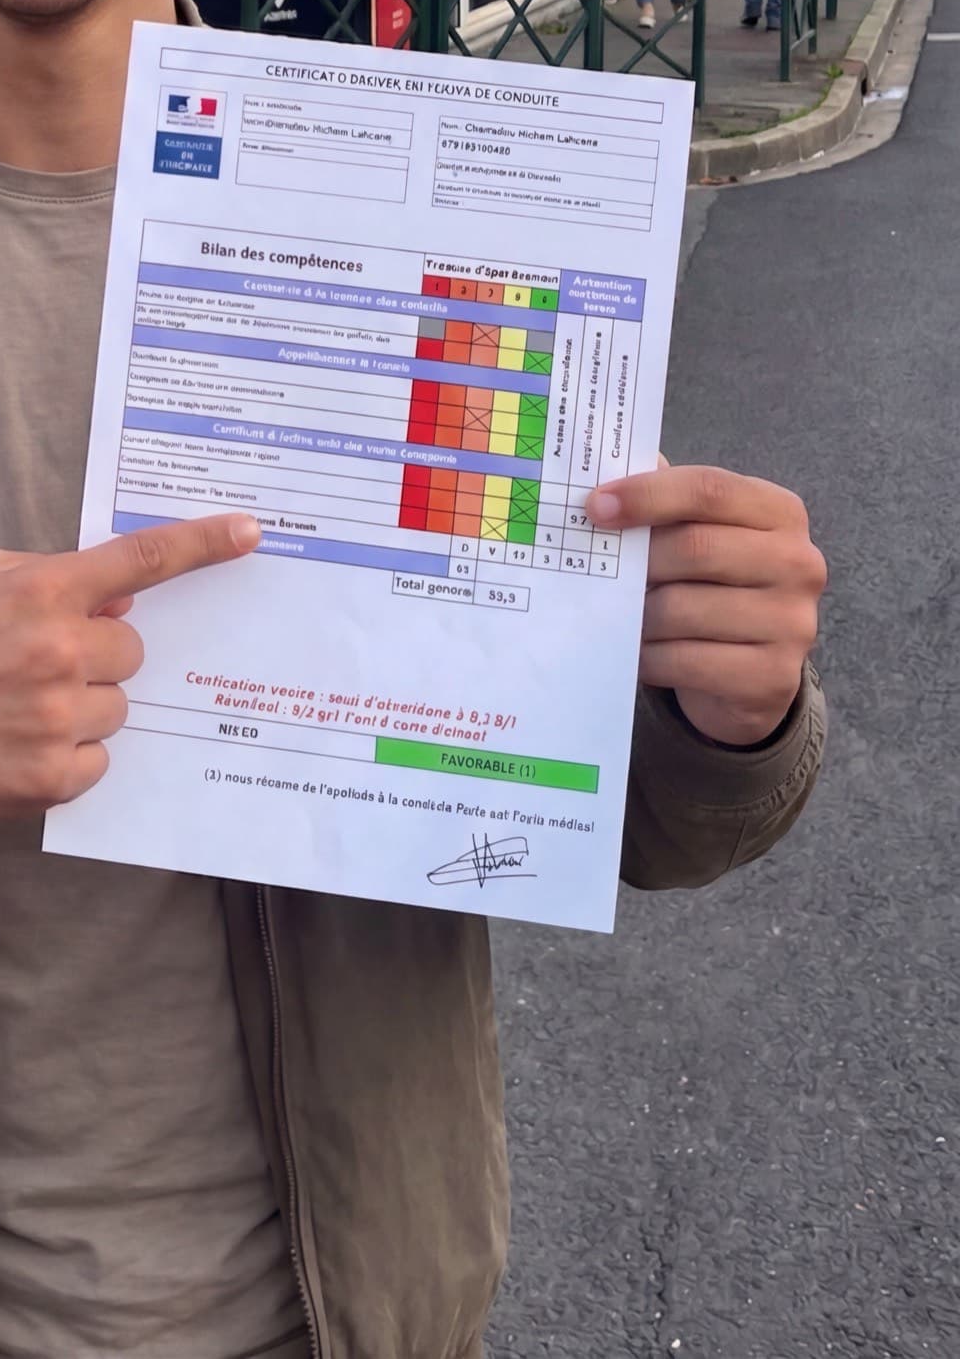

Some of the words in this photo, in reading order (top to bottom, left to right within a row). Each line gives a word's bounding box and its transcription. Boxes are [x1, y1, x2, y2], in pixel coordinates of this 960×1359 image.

[475, 87, 491, 99] DE
[494, 89, 560, 107] CONDUITE
[201, 242, 236, 258] Bilan
[240, 246, 265, 261] des
[395, 577, 425, 591] Total
[441, 753, 515, 774] FAVORABLE
[520, 763, 536, 778] (1)
[225, 772, 253, 785] nous
[302, 781, 316, 793] de
[389, 793, 398, 805] la
